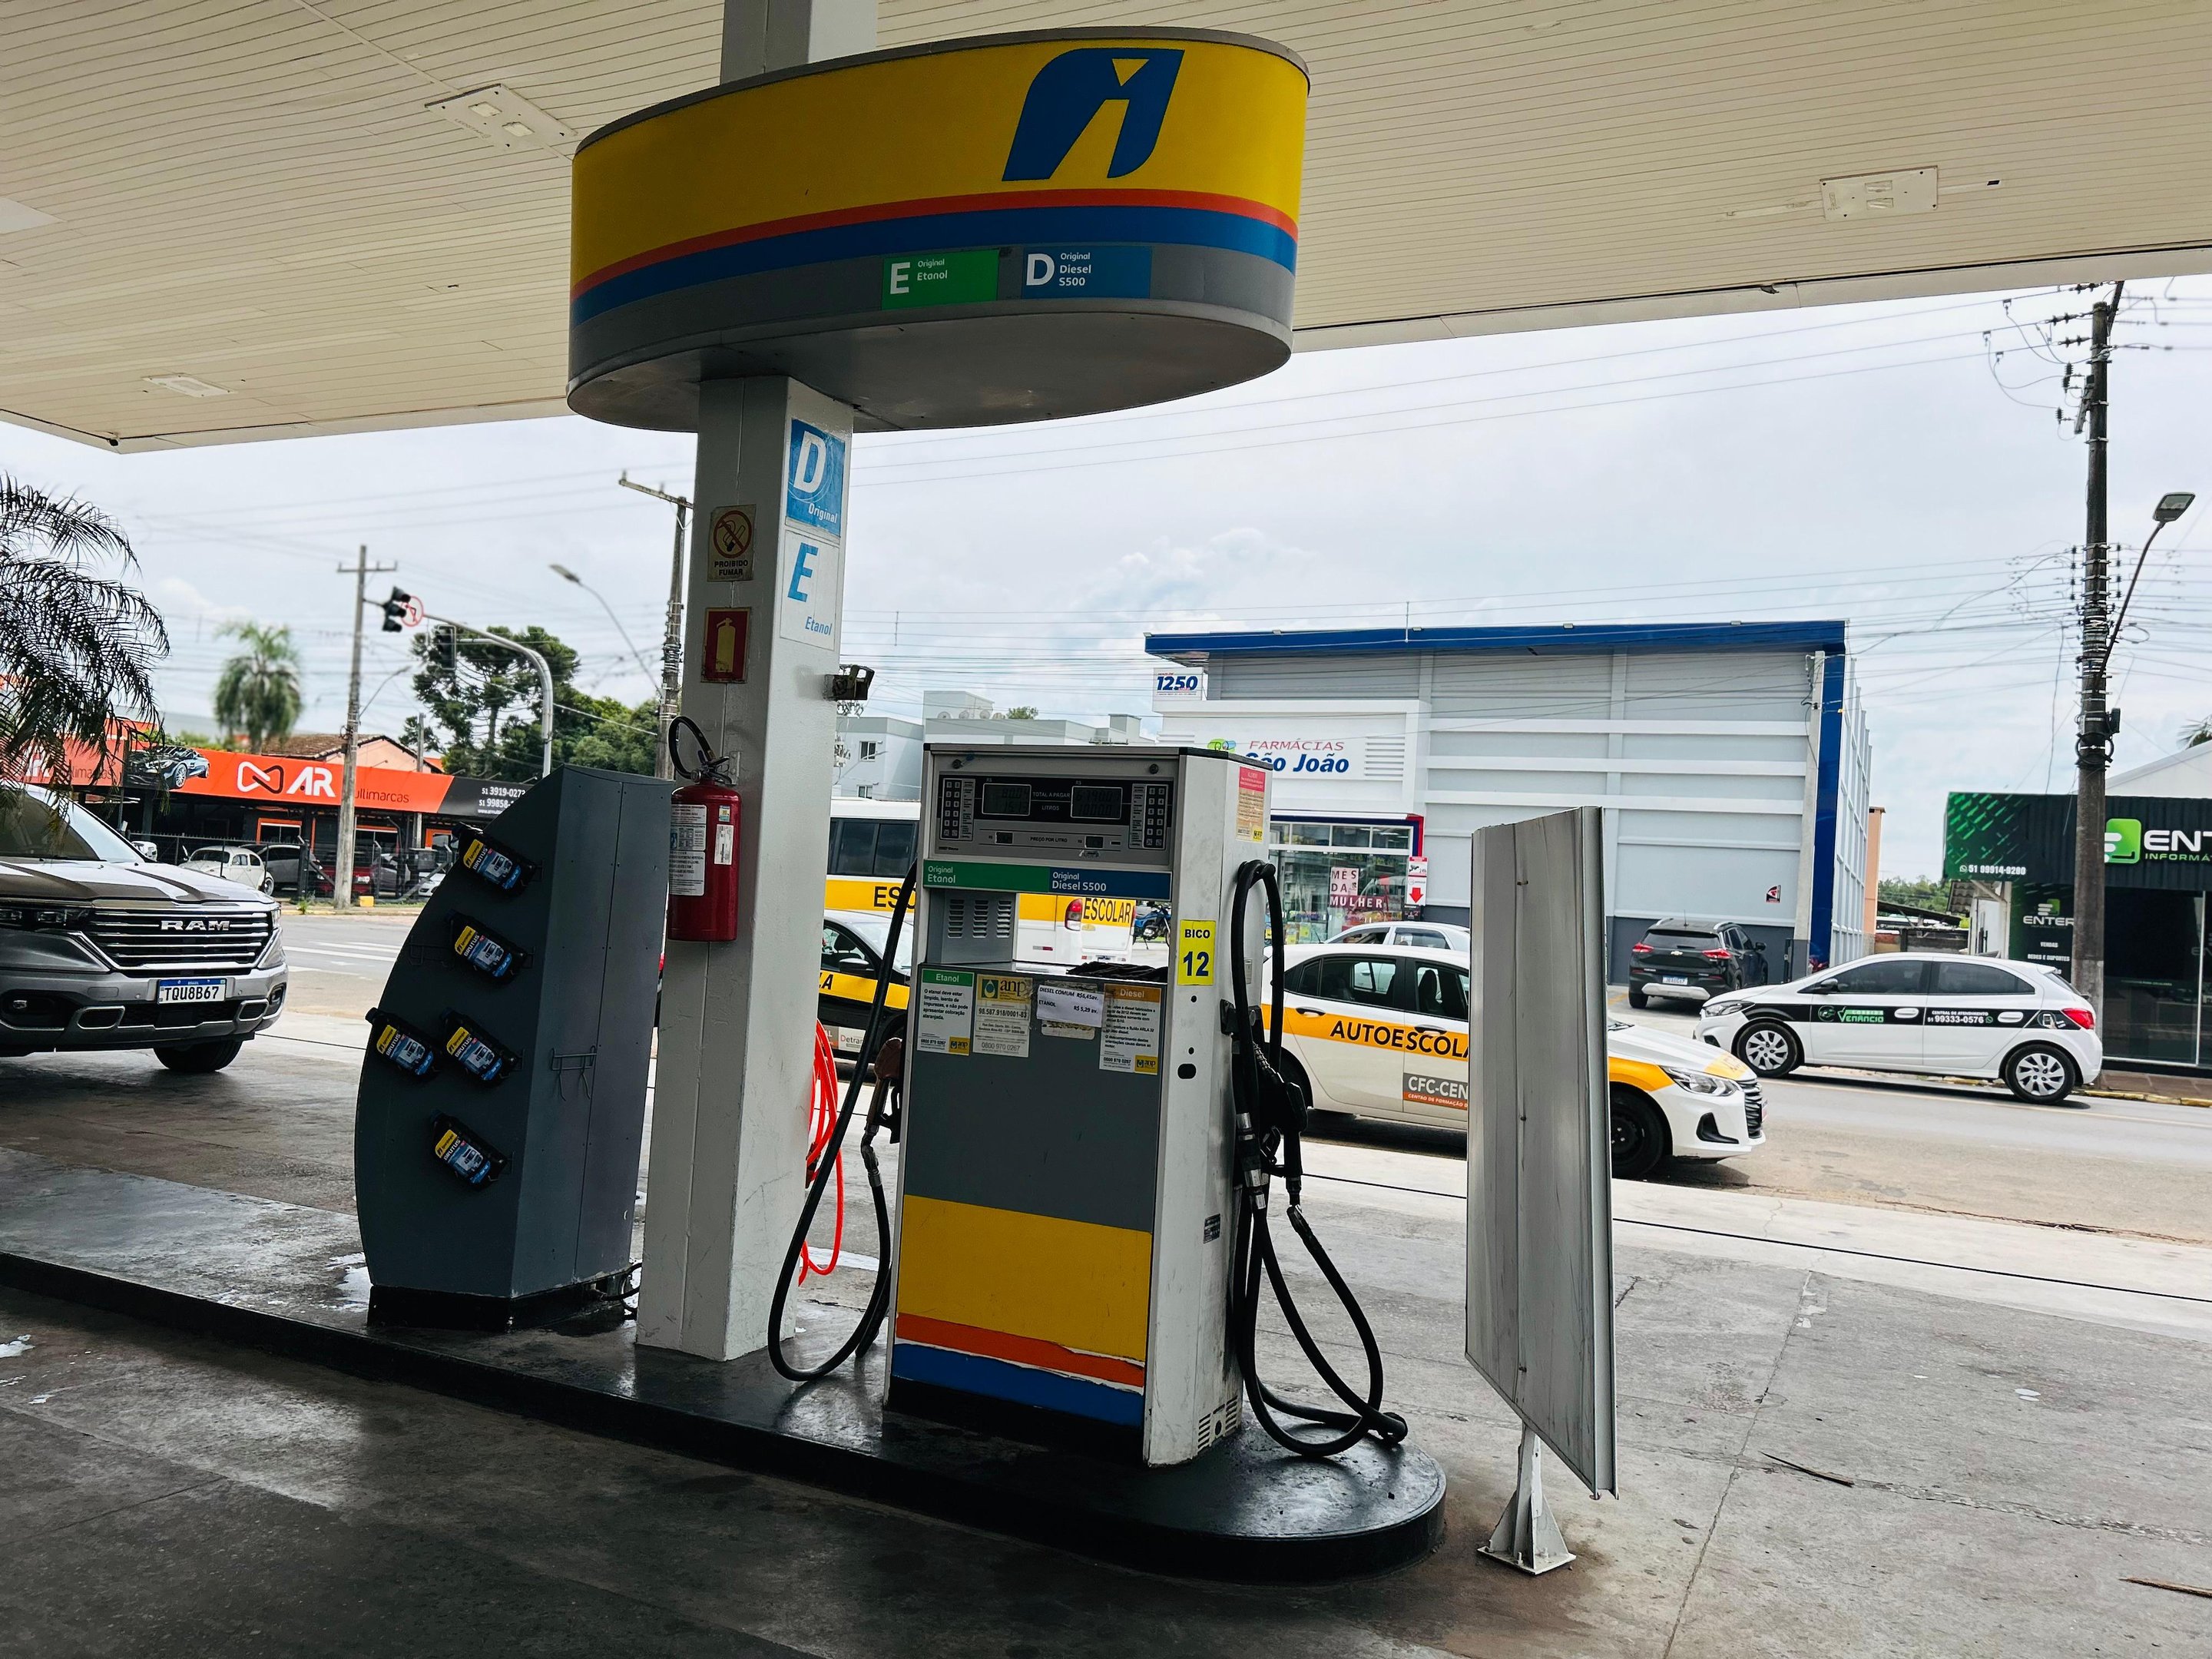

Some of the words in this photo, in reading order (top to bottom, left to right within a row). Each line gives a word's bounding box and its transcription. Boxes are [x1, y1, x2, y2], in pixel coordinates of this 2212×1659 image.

[918, 258, 945, 269] Original
[1060, 253, 1091, 262] Original
[1026, 253, 1055, 286] D
[1059, 264, 1091, 274] Diesel
[889, 262, 911, 295] E
[917, 270, 949, 282] Etanol
[1059, 277, 1086, 287] S500
[793, 430, 826, 494] D
[808, 502, 839, 525] Original
[714, 560, 749, 569] PROIBIDO
[719, 568, 743, 577] FUMAR
[787, 541, 820, 603] E
[805, 616, 833, 637] Etanol
[1157, 676, 1198, 690] 1250
[1250, 738, 1345, 751] FARMÁCIAS
[1293, 753, 1349, 773] João
[286, 766, 336, 798] AR
[355, 787, 409, 803] ultimarcas
[487, 798, 514, 809] 99858-
[472, 847, 488, 870] BRUTUS
[2145, 853, 2212, 862] INFORMÁ
[927, 865, 953, 874] Original
[1969, 864, 1978, 873] 51
[927, 874, 956, 884] Etanol
[1052, 871, 1080, 881] Original
[1051, 880, 1081, 891] Diesel
[1081, 882, 1107, 892] S500
[1331, 883, 1348, 893] DA
[1330, 896, 1383, 909] MULHER
[1083, 897, 1131, 924] ESCOLAR
[161, 920, 230, 931] RAM
[2022, 916, 2075, 926] ENTER
[1184, 929, 1210, 939] BICO
[463, 935, 480, 957] BRUTUS
[1183, 951, 1210, 976] 12
[935, 973, 959, 982] Etanol
[164, 986, 220, 1002] TQU8B67
[1000, 979, 1027, 997] anp
[1120, 988, 1145, 998] Diesel
[1038, 999, 1056, 1008] ETANOL
[1934, 1015, 1985, 1024] 99333-0576
[386, 1033, 401, 1056] BRUTUS
[455, 1037, 472, 1058] BRUTUS
[1408, 1076, 1468, 1100] CFC-CEN
[1435, 1097, 1463, 1108] FORMAÇÃO
[443, 1139, 461, 1161] BRUTUS
